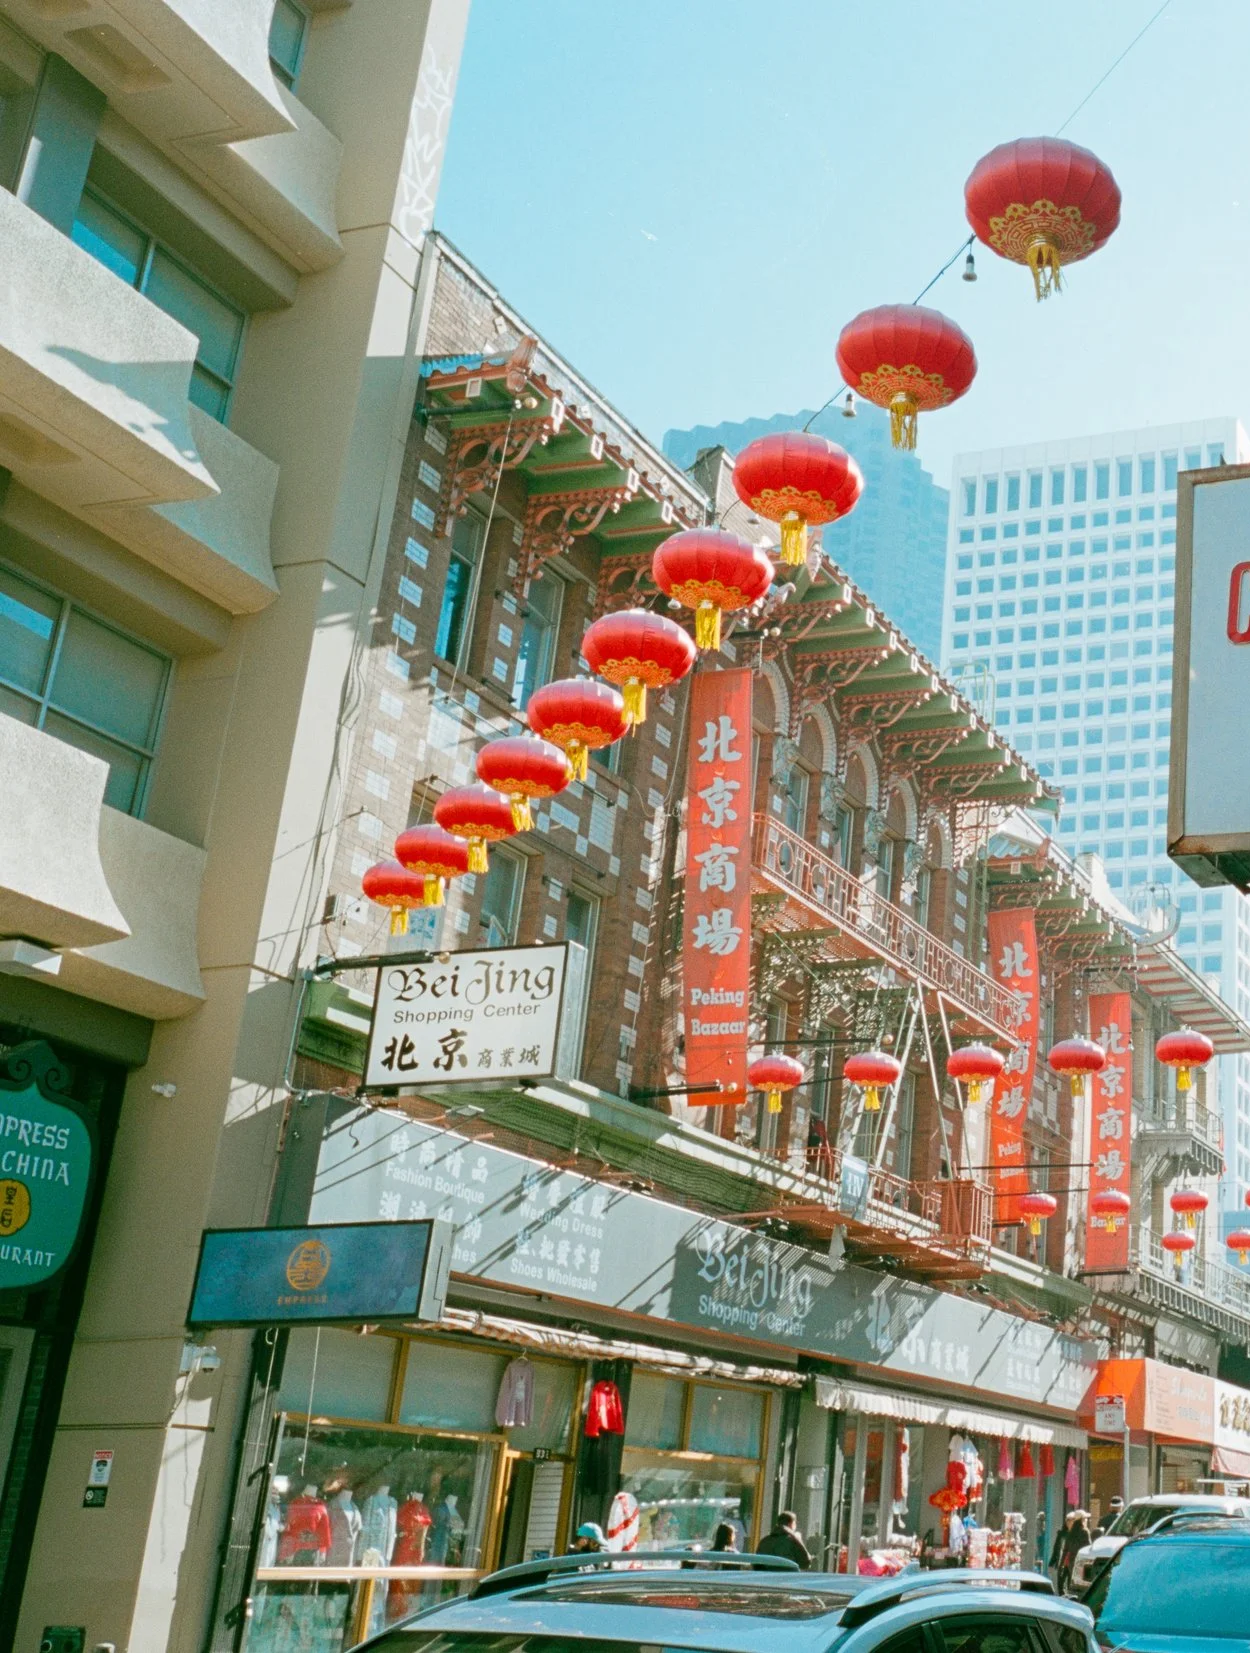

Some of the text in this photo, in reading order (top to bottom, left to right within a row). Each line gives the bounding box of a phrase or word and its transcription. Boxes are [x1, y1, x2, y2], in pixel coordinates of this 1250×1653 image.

[692, 714, 744, 957] 北京商場
[393, 1002, 541, 1025] Shopping Center
[691, 987, 745, 1008] Peking
[691, 1015, 746, 1037] Bazaar
[2, 1150, 70, 1187] CHINA
[510, 1257, 598, 1293] Shoes Wholesale
[698, 1293, 806, 1338] Shopping Center
